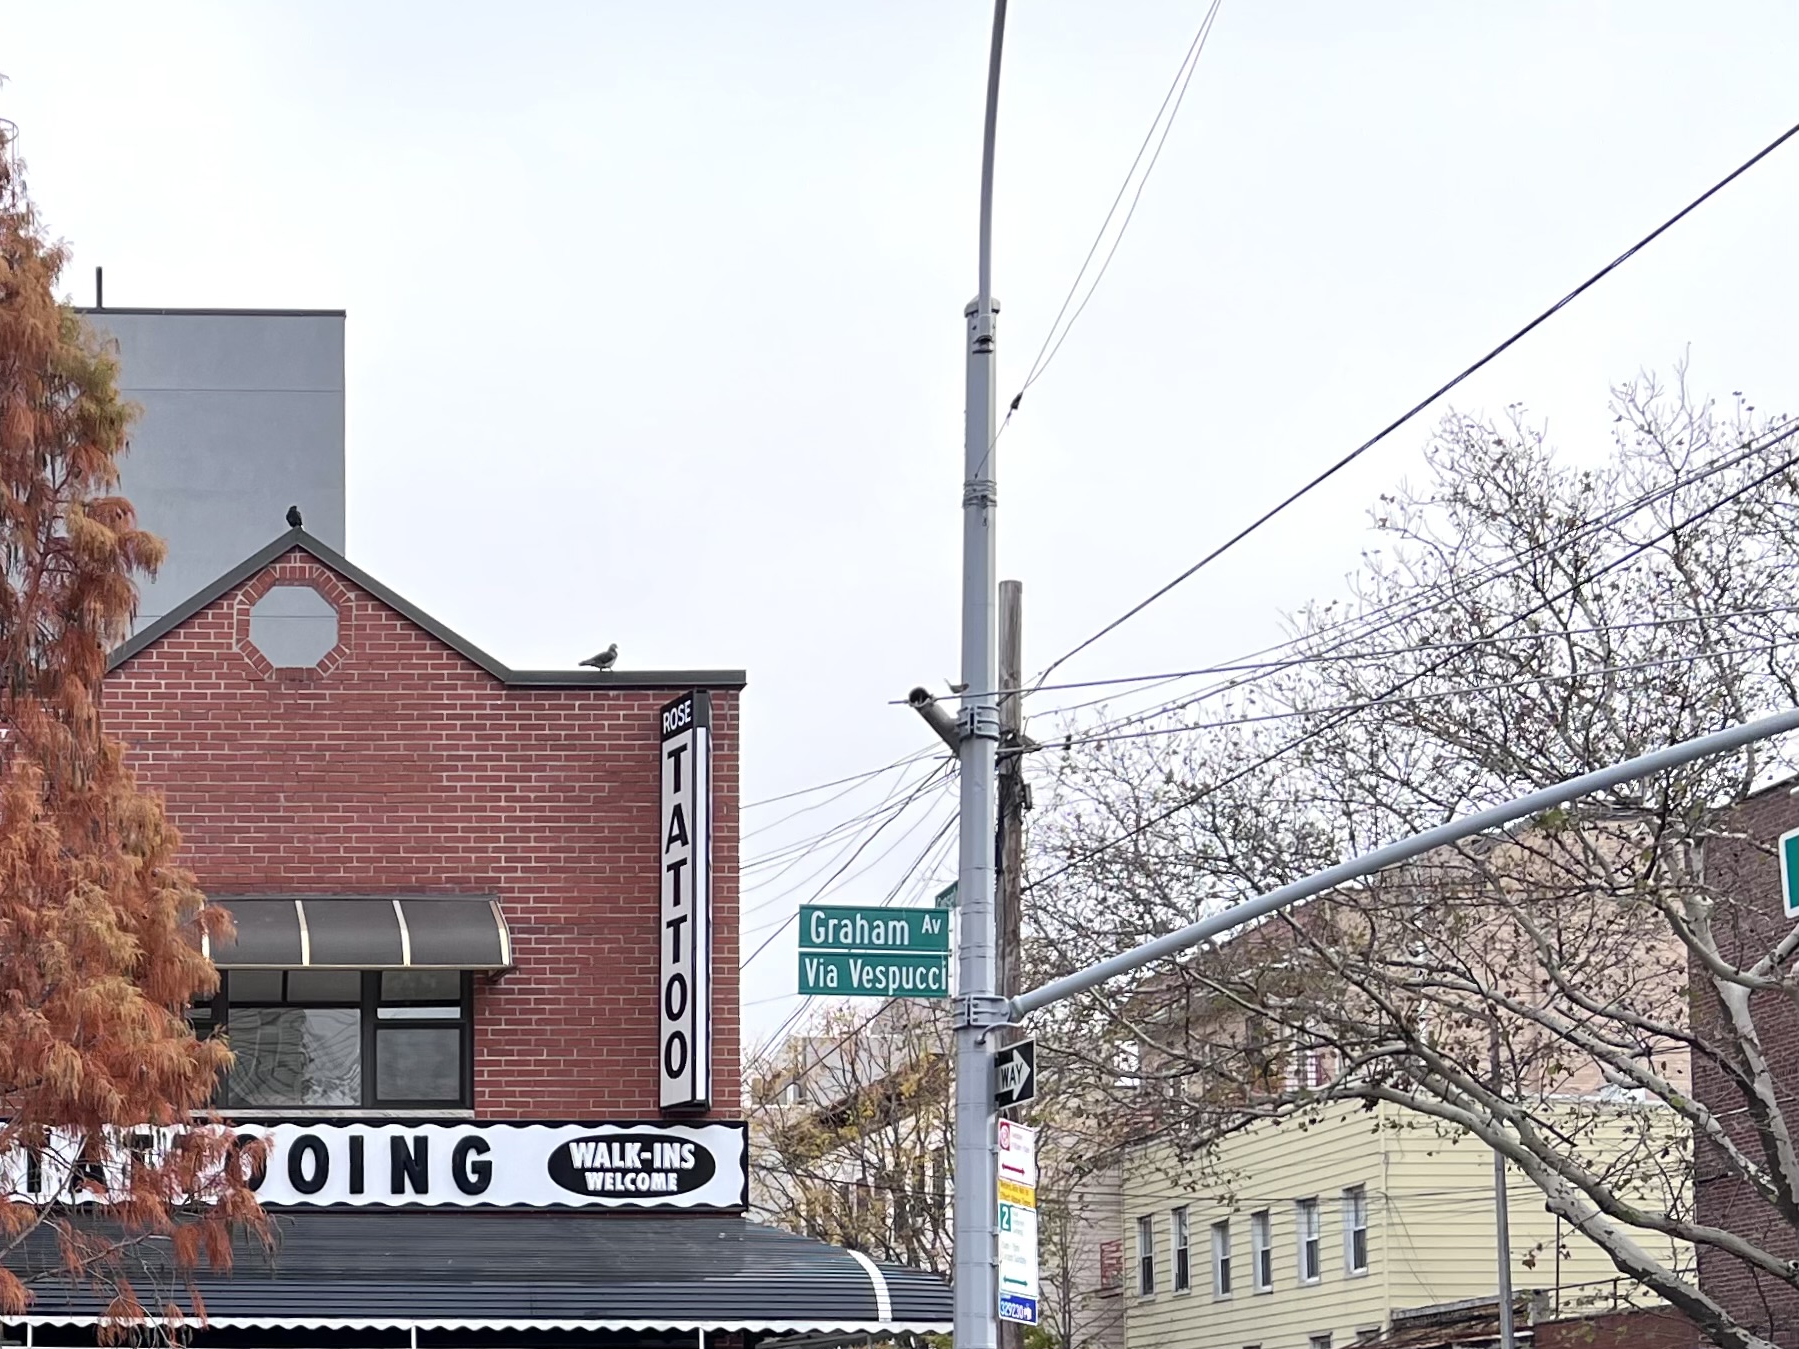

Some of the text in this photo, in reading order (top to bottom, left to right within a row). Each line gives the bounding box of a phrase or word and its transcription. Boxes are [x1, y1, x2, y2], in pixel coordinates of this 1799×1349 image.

[663, 699, 692, 735] ROSE
[664, 742, 690, 1080] TATTOO
[810, 910, 942, 946] Graham Av
[804, 957, 947, 996] Via Vespucci
[1001, 1062, 1023, 1091] WAY
[568, 1141, 696, 1170] WALK-INS
[584, 1171, 679, 1192] WELCOME
